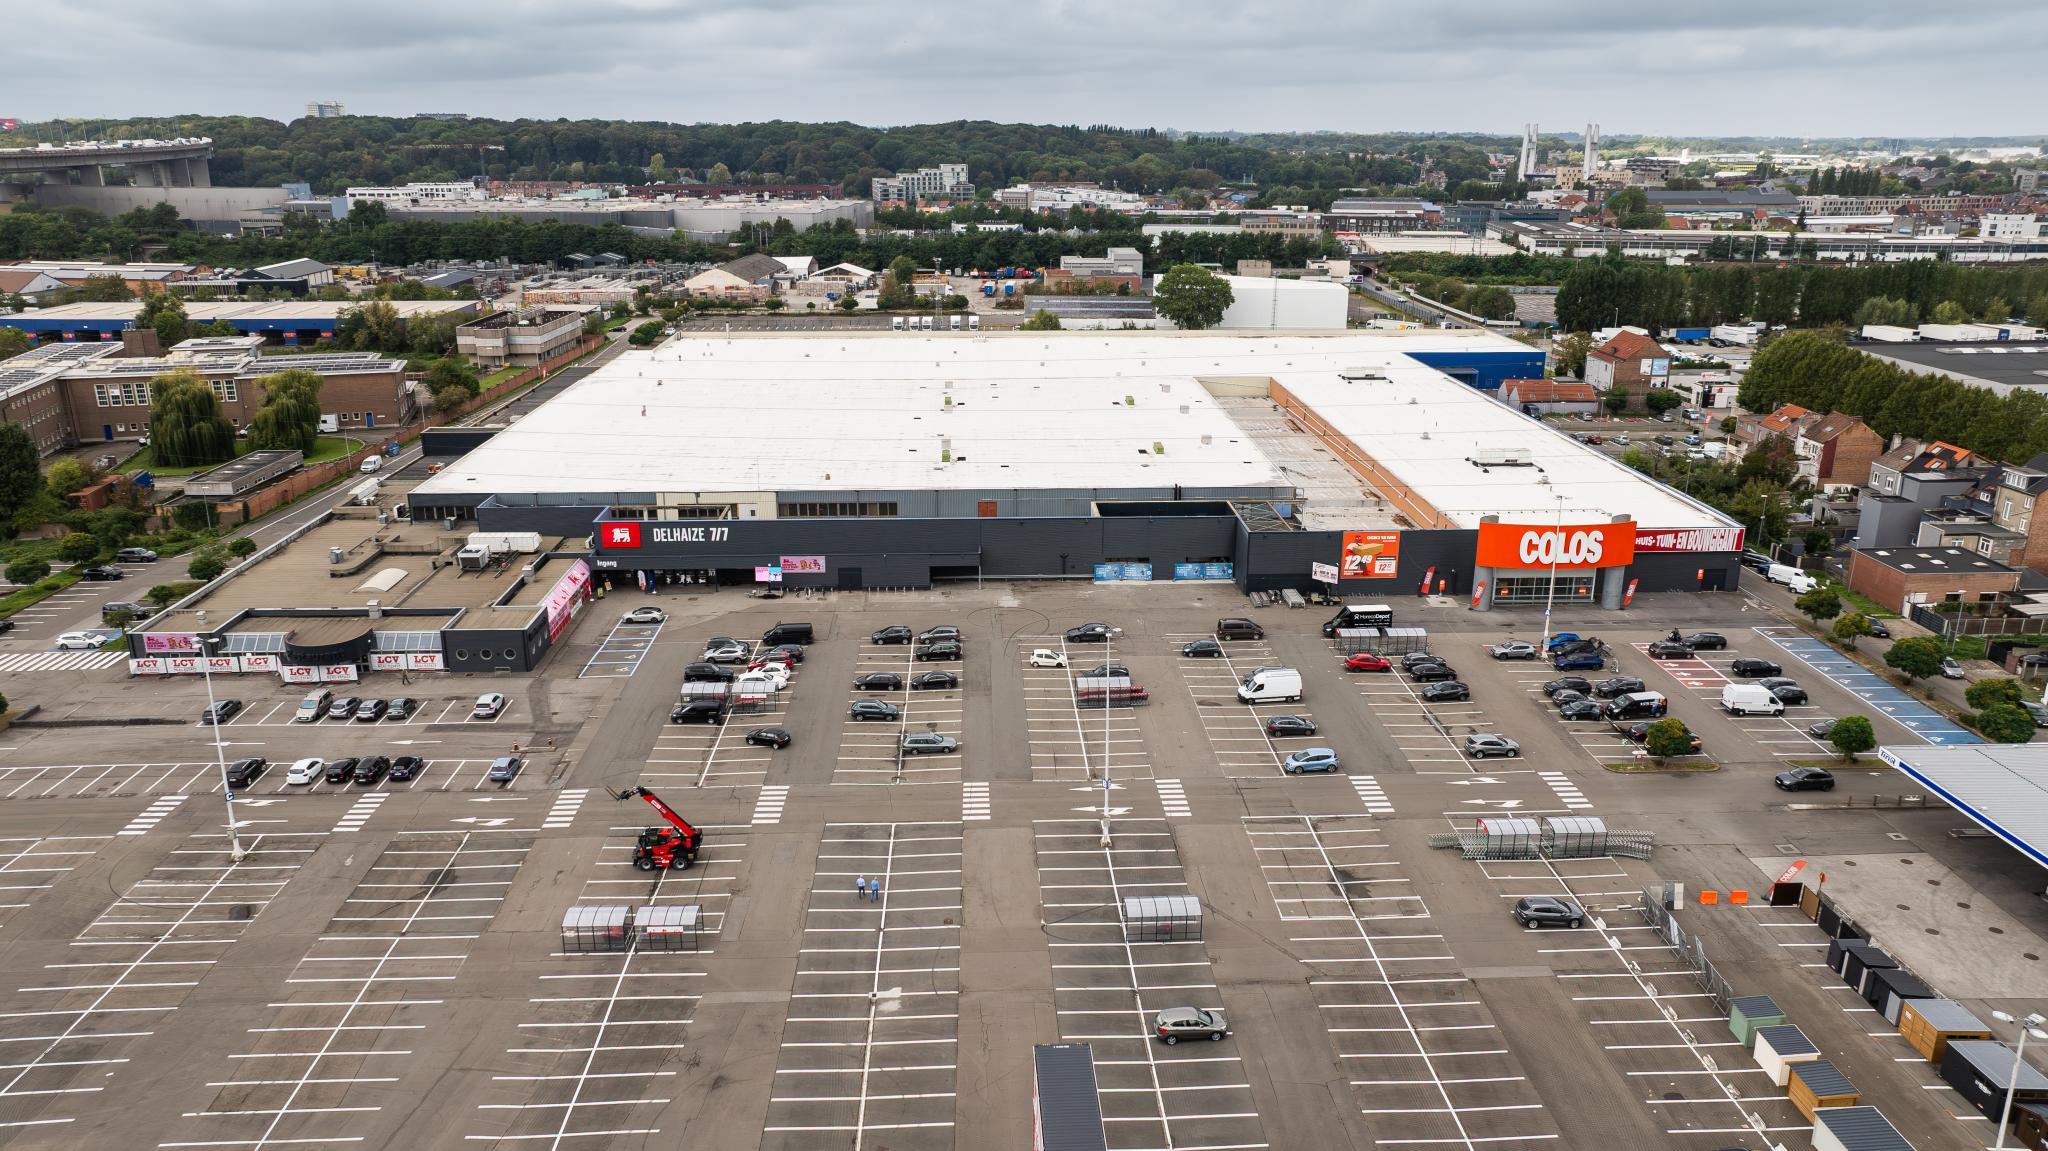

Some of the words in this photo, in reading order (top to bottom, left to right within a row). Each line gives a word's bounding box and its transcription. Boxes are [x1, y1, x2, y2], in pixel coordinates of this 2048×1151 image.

[653, 527, 705, 542] DELHAIZE
[709, 527, 729, 541] 7/7
[1676, 531, 1689, 549] EN
[1687, 528, 1740, 551] BOUWGIGANT
[1519, 530, 1604, 564] COLOS
[173, 659, 195, 667] LCV
[247, 657, 269, 665] LCV
[414, 655, 436, 663] LCV
[136, 660, 158, 668] LCV
[326, 667, 350, 675] LCV
[226, 792, 233, 800] C
